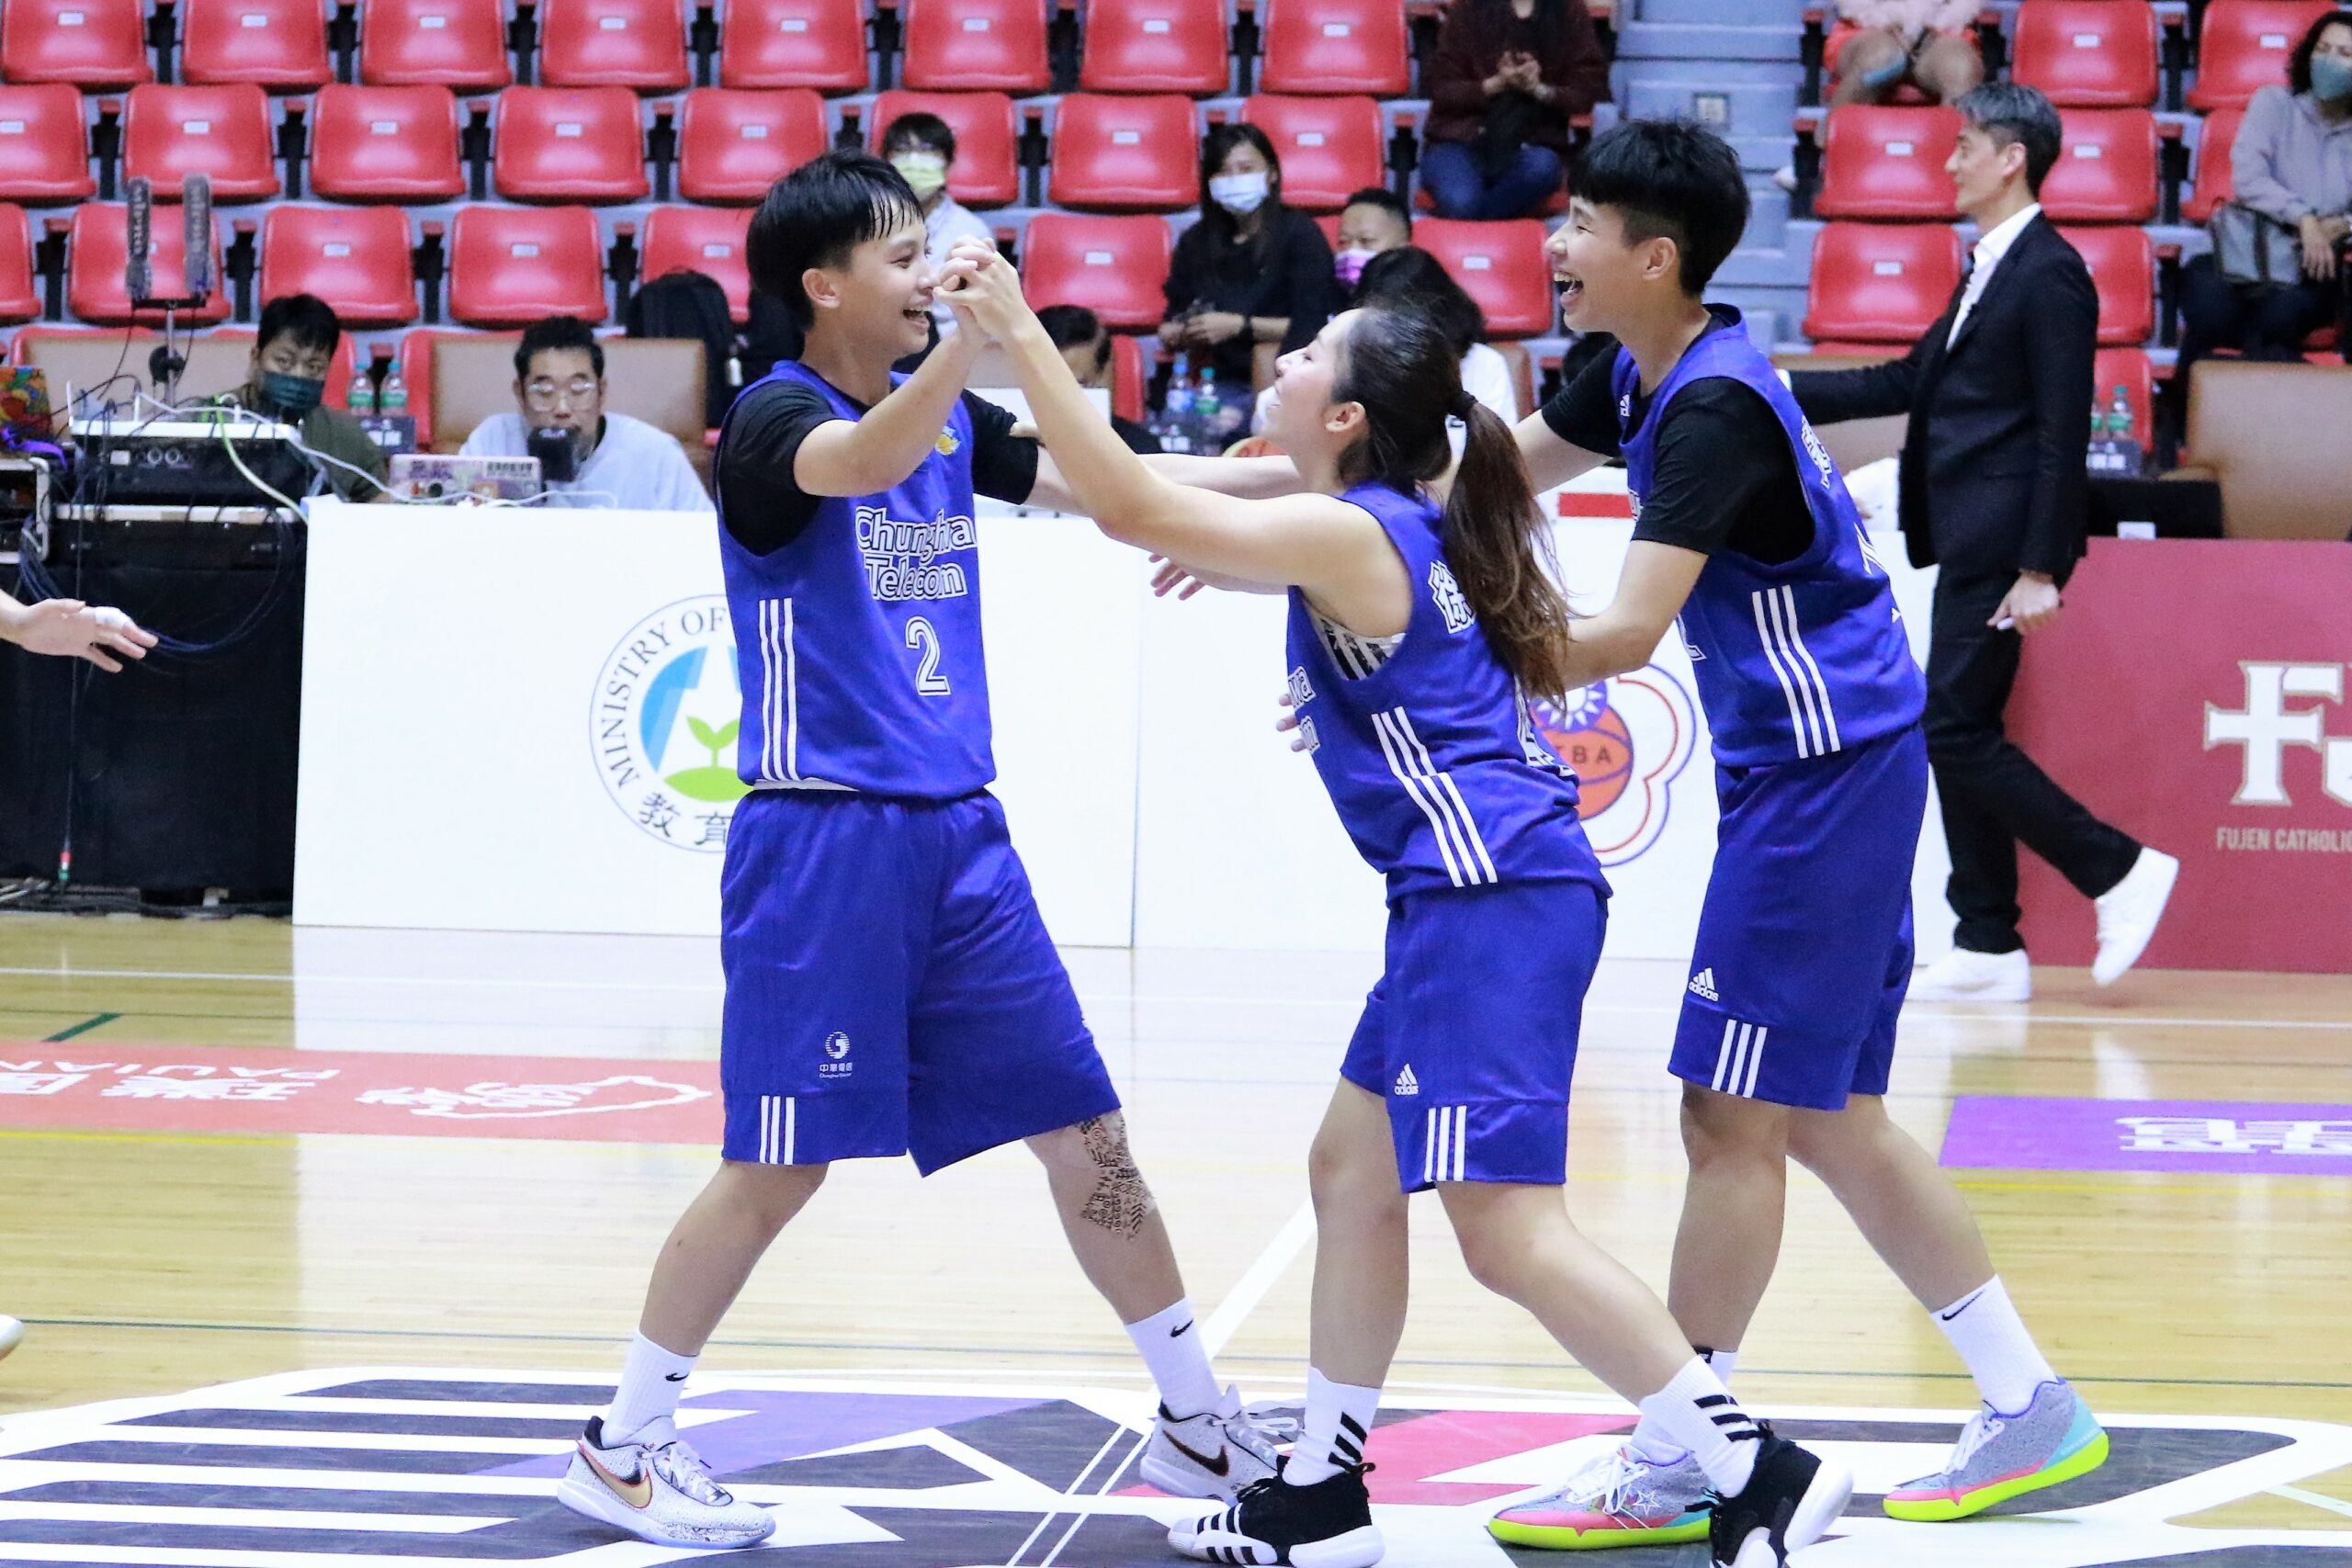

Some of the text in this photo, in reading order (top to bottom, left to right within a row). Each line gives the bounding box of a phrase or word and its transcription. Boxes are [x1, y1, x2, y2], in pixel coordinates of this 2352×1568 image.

[905, 616, 952, 696] 2
[602, 606, 727, 789] MINISTRY OF
[2216, 827, 2271, 850] FUJEN
[1688, 981, 1719, 1002] adidas
